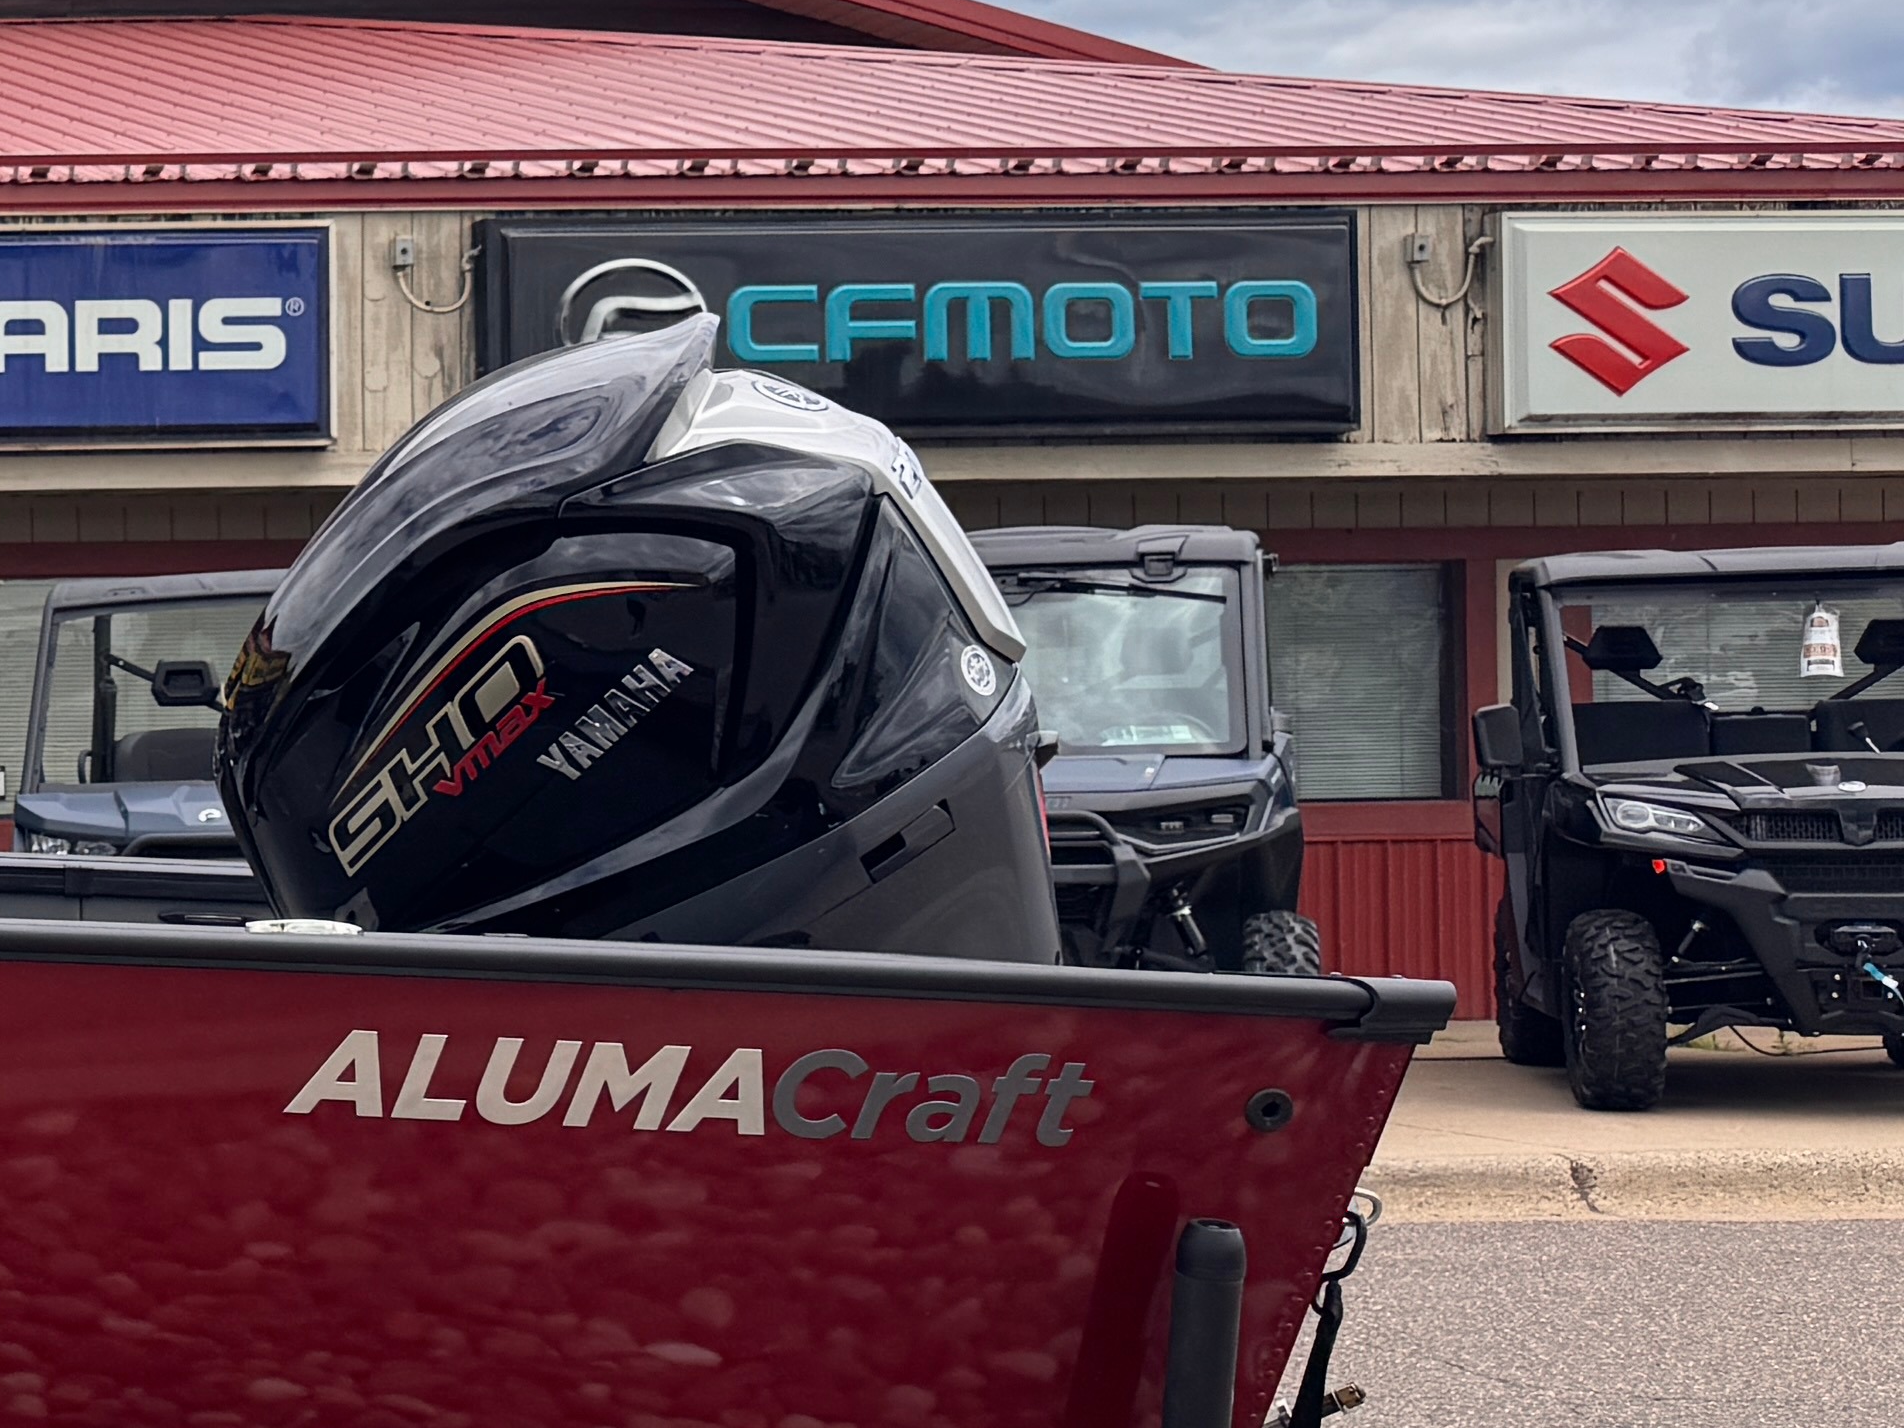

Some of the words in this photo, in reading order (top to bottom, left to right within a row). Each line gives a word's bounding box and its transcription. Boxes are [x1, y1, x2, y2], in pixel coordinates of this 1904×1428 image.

[725, 280, 1320, 363] CFMOTO
[328, 634, 545, 877] SHO
[536, 647, 694, 781] YAMAHA
[284, 1028, 1096, 1148] ALUMACraft
